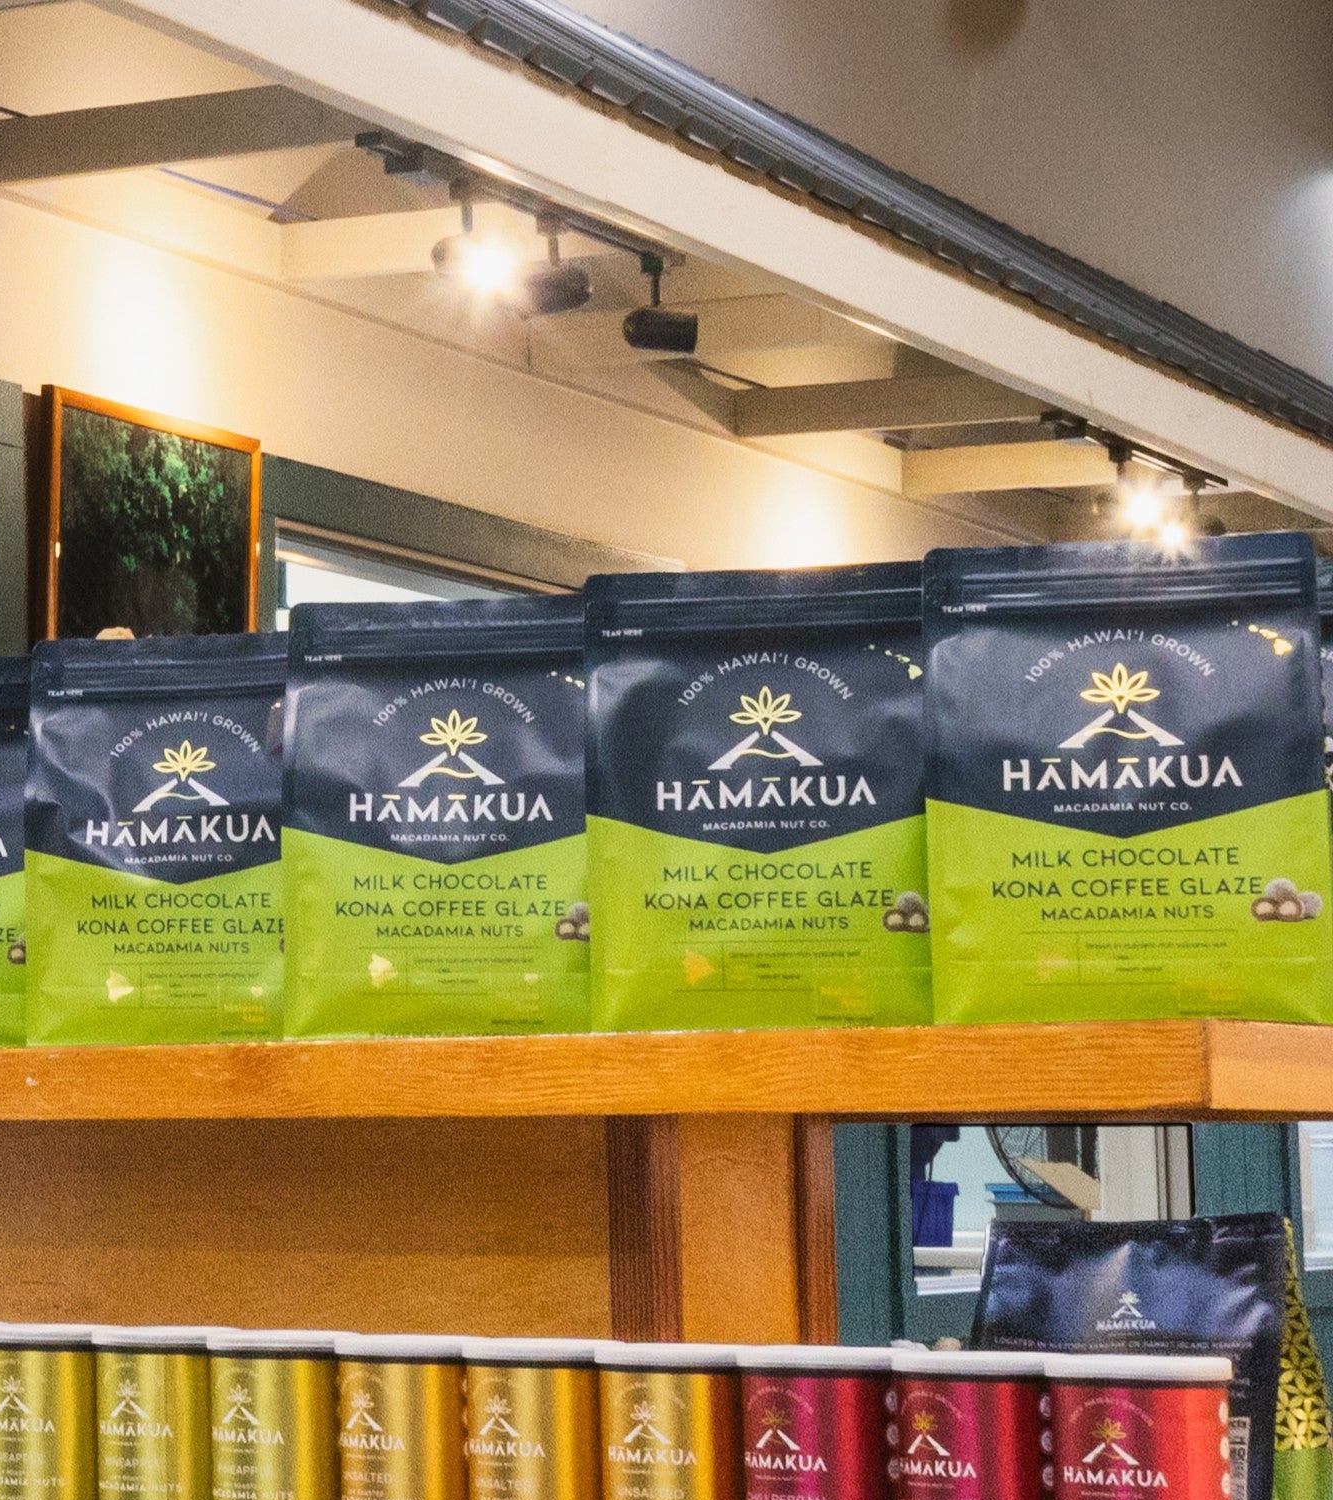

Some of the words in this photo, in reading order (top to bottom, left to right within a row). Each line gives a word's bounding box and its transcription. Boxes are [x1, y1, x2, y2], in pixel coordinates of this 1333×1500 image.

[1025, 648, 1064, 683] 100%
[1150, 633, 1215, 677] GROWN
[677, 672, 715, 706] 100%
[794, 656, 853, 701] GROWN
[373, 697, 408, 727] 100%
[482, 681, 535, 724] GROWN
[1002, 755, 1243, 792] HĀMĀKUA
[1054, 803, 1134, 813] MACADAMIA
[1139, 802, 1165, 812] NUT
[1170, 802, 1192, 811] CO.
[702, 820, 775, 831] MACADAMIA
[781, 819, 805, 830] NUT
[391, 833, 460, 842] MACADAMIA
[463, 833, 487, 842] NUT
[1012, 851, 1071, 869] MILK
[1082, 847, 1240, 867] CHOCOLATE
[664, 865, 718, 882] MILK
[727, 861, 872, 881] CHOCOLATE
[354, 875, 404, 890] MILK
[413, 874, 547, 890] CHOCOLATE
[992, 880, 1061, 898] KONA
[1071, 878, 1169, 897] COFFEE
[1180, 876, 1262, 896] GLAZE
[92, 894, 137, 908] MILK
[144, 893, 272, 908] CHOCOLATE
[335, 901, 393, 917] KONA
[402, 901, 487, 917] COFFEE
[495, 900, 565, 917] GLAZE
[645, 893, 707, 910] KONA
[718, 891, 807, 909] COFFEE
[817, 890, 894, 908] GLAZE
[1041, 906, 1156, 921] MACADAMIA
[1164, 904, 1214, 920] NUTS
[77, 920, 129, 935] KONA
[137, 918, 214, 934] COFFEE
[223, 918, 284, 934] GLAZE
[376, 926, 474, 937] MACADAMIA
[481, 925, 524, 937] NUTS
[689, 918, 795, 932] MACADAMIA
[802, 916, 848, 930] NUTS
[114, 942, 203, 954] MACADAMIA
[210, 941, 250, 953] NUTS
